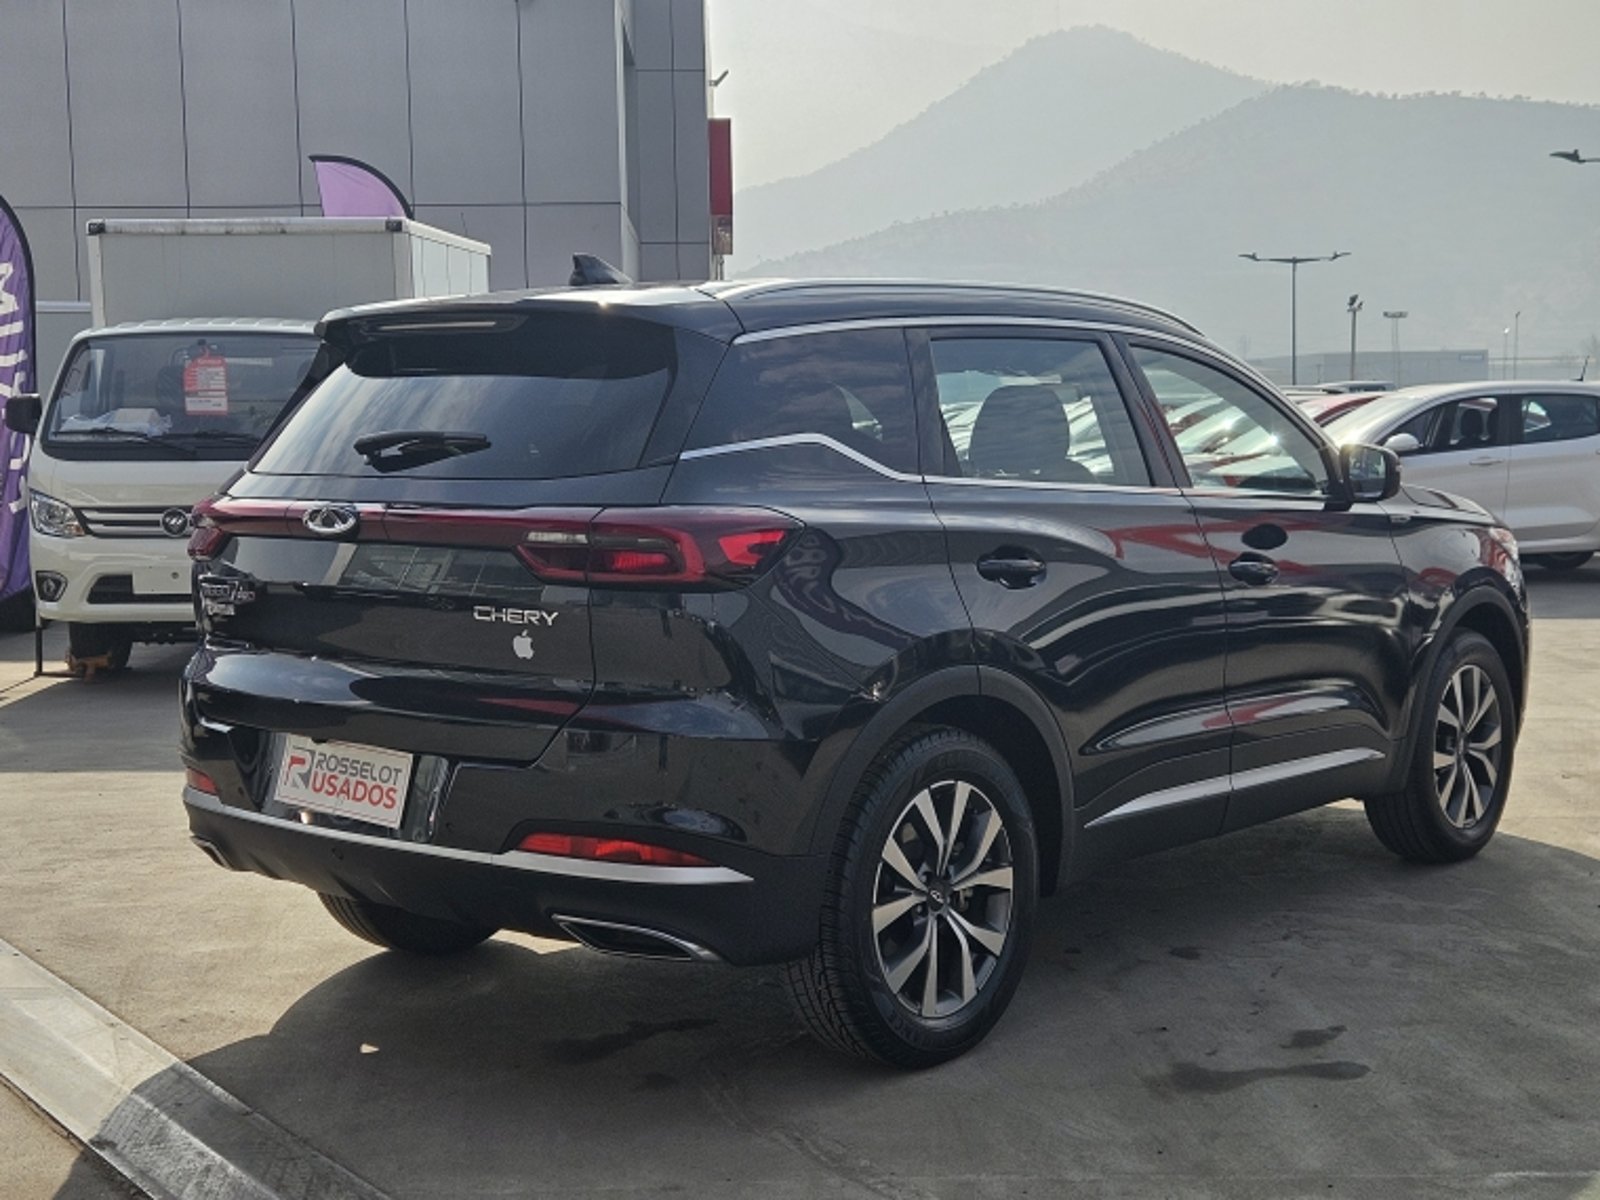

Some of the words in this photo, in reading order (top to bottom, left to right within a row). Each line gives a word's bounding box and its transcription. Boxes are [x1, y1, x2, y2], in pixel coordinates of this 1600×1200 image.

[473, 605, 559, 626] CHERY
[315, 752, 403, 786] ROSSELOT
[311, 770, 398, 810] USADOS
